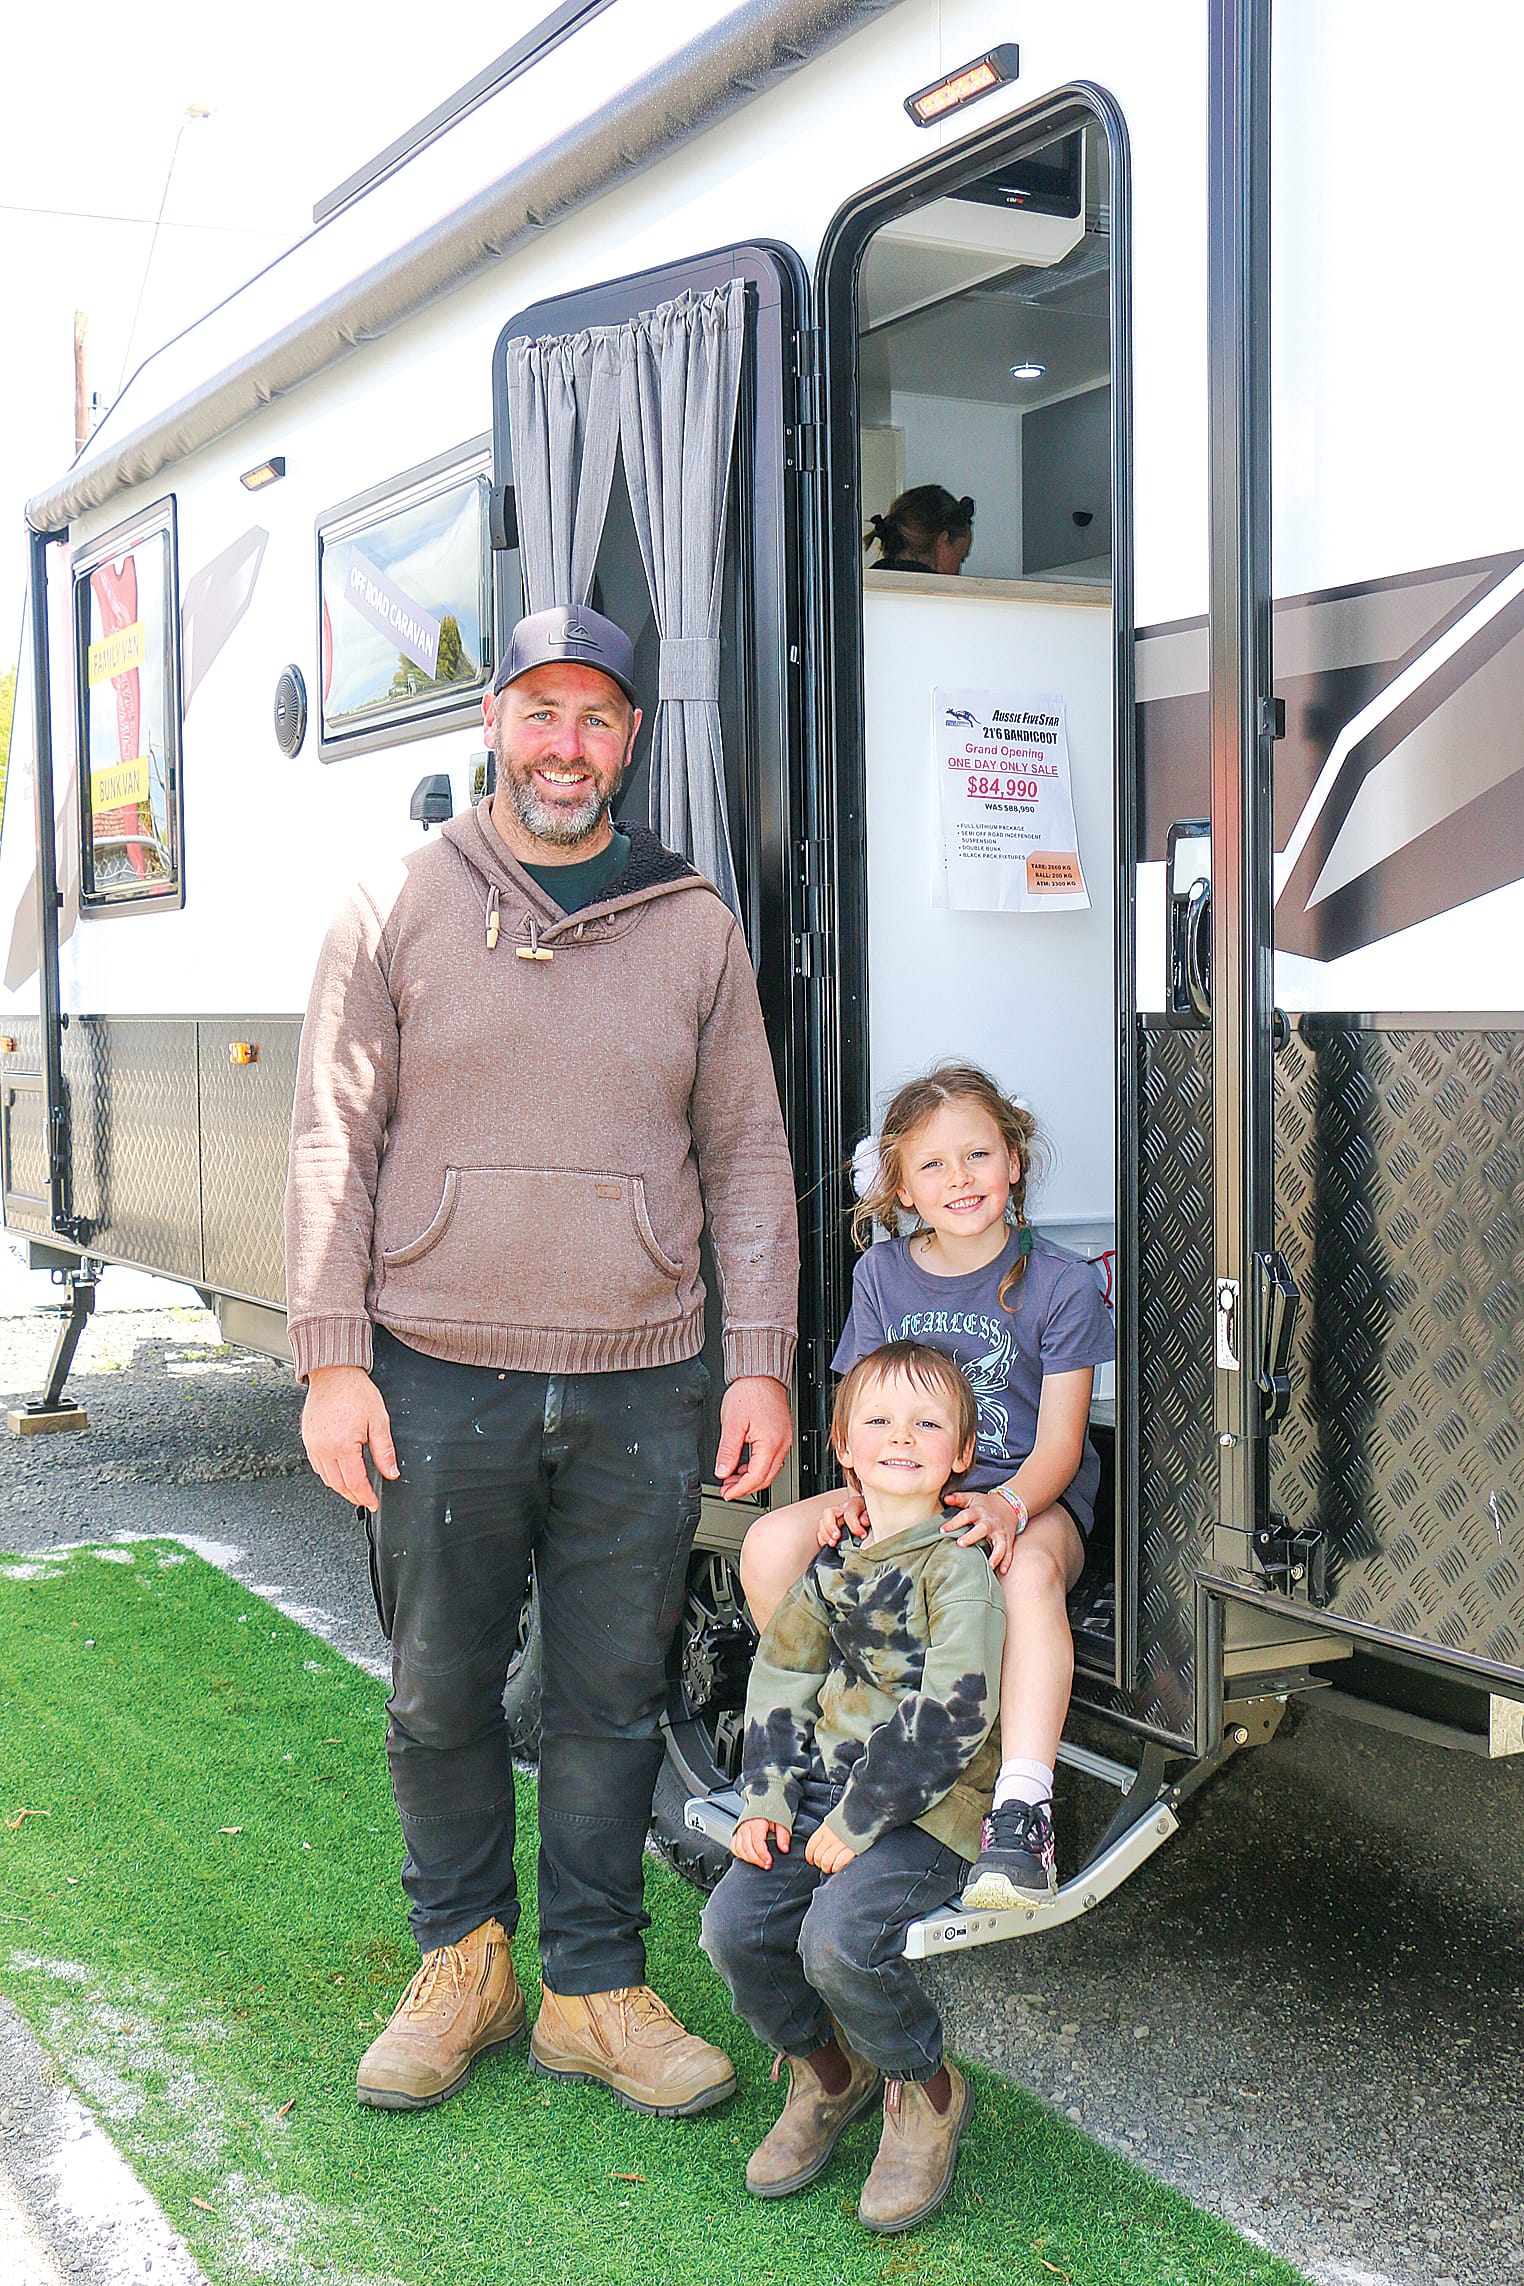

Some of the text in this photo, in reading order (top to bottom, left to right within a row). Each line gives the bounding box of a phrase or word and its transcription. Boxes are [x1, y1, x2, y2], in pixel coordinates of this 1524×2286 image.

[350, 567, 434, 658] OFF ROAD CARAVAN
[94, 632, 139, 678] FAMILY VAN
[992, 710, 1022, 723] AUSSIE
[983, 726, 1058, 744] 21'6 BANDICOOT
[965, 743, 1044, 761] Grand Opening
[948, 757, 1058, 775] ONE DAY ONLY SALE
[100, 770, 140, 803] BUNK VAN
[967, 775, 1038, 799] $84,990
[984, 803, 1003, 811] WAS
[900, 1310, 1001, 1348] FEARLESS
